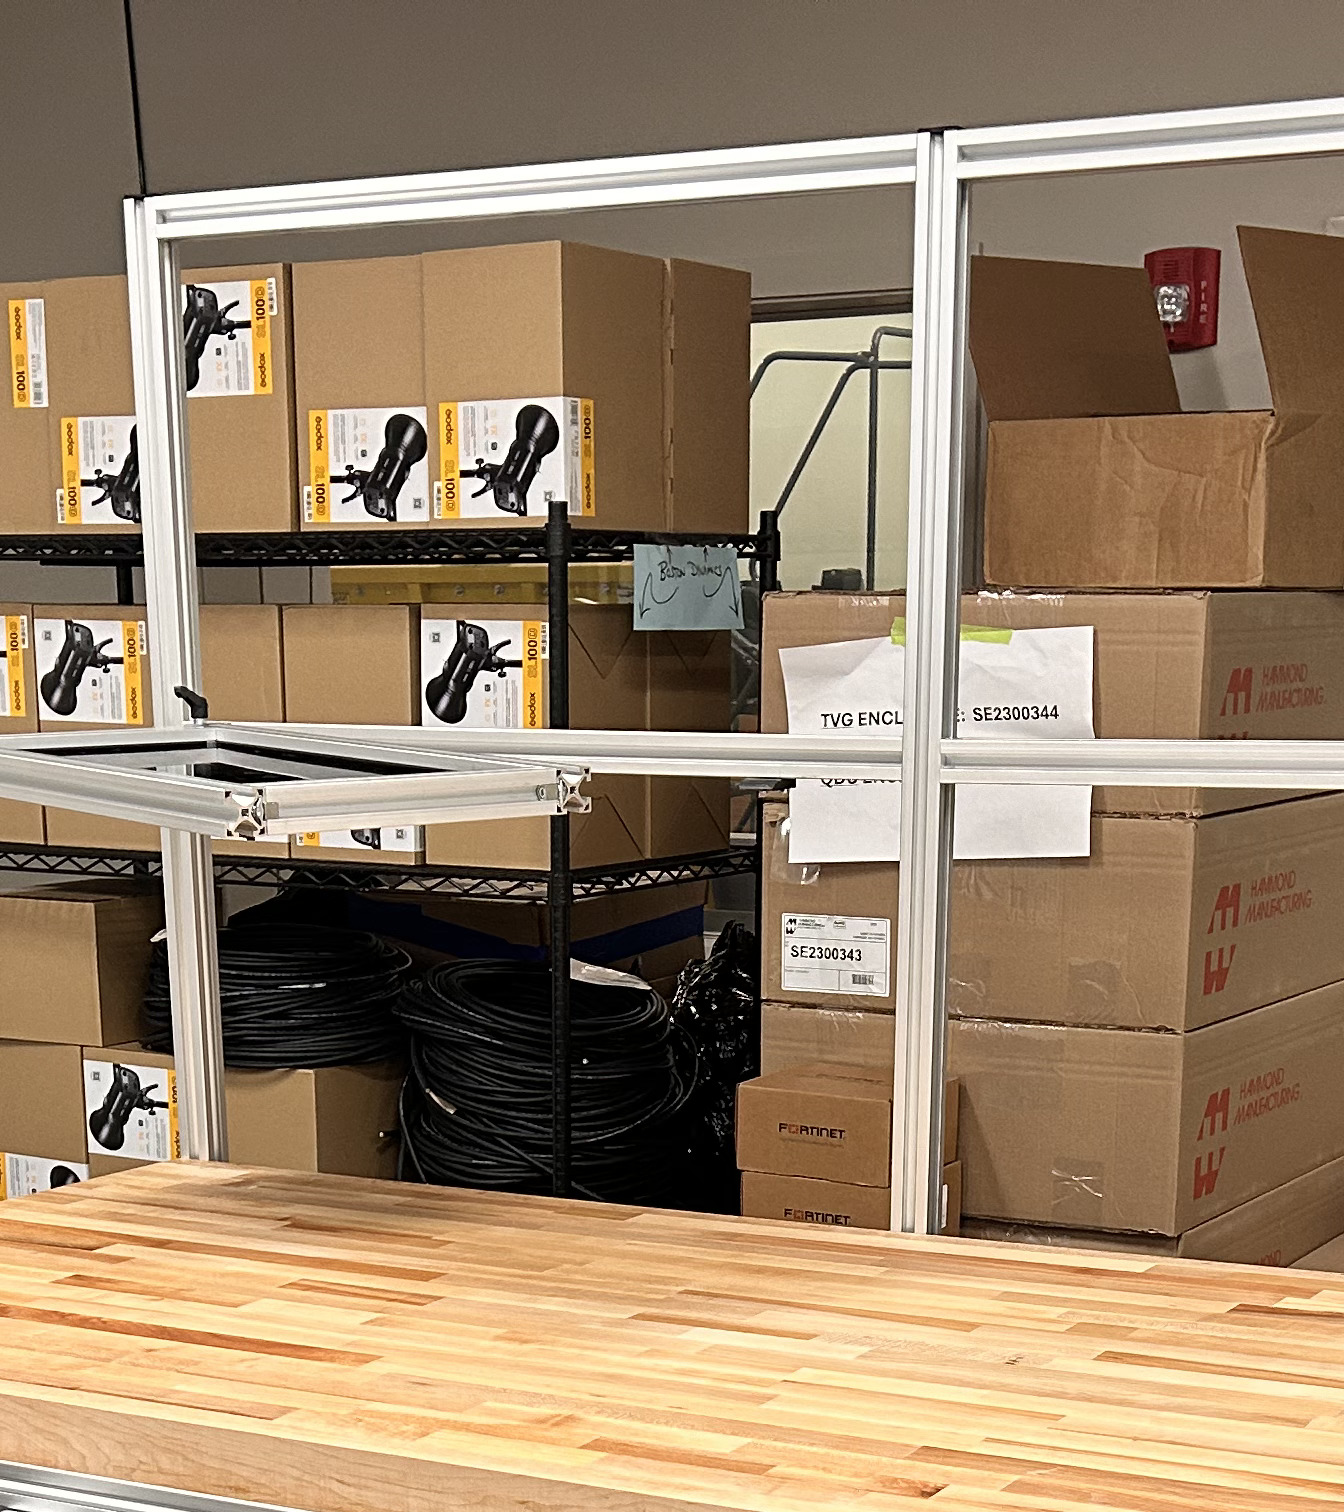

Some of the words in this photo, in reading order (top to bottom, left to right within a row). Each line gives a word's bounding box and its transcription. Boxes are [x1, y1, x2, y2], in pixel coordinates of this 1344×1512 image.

[821, 713, 854, 727] TVG
[973, 705, 1060, 722] SE2300344
[1250, 870, 1296, 898] HAMMOND
[791, 945, 862, 962] SE2300343
[1240, 1068, 1284, 1100] HAMMOND
[778, 1122, 846, 1140] FORTINET
[784, 1208, 851, 1225] FORTINET
